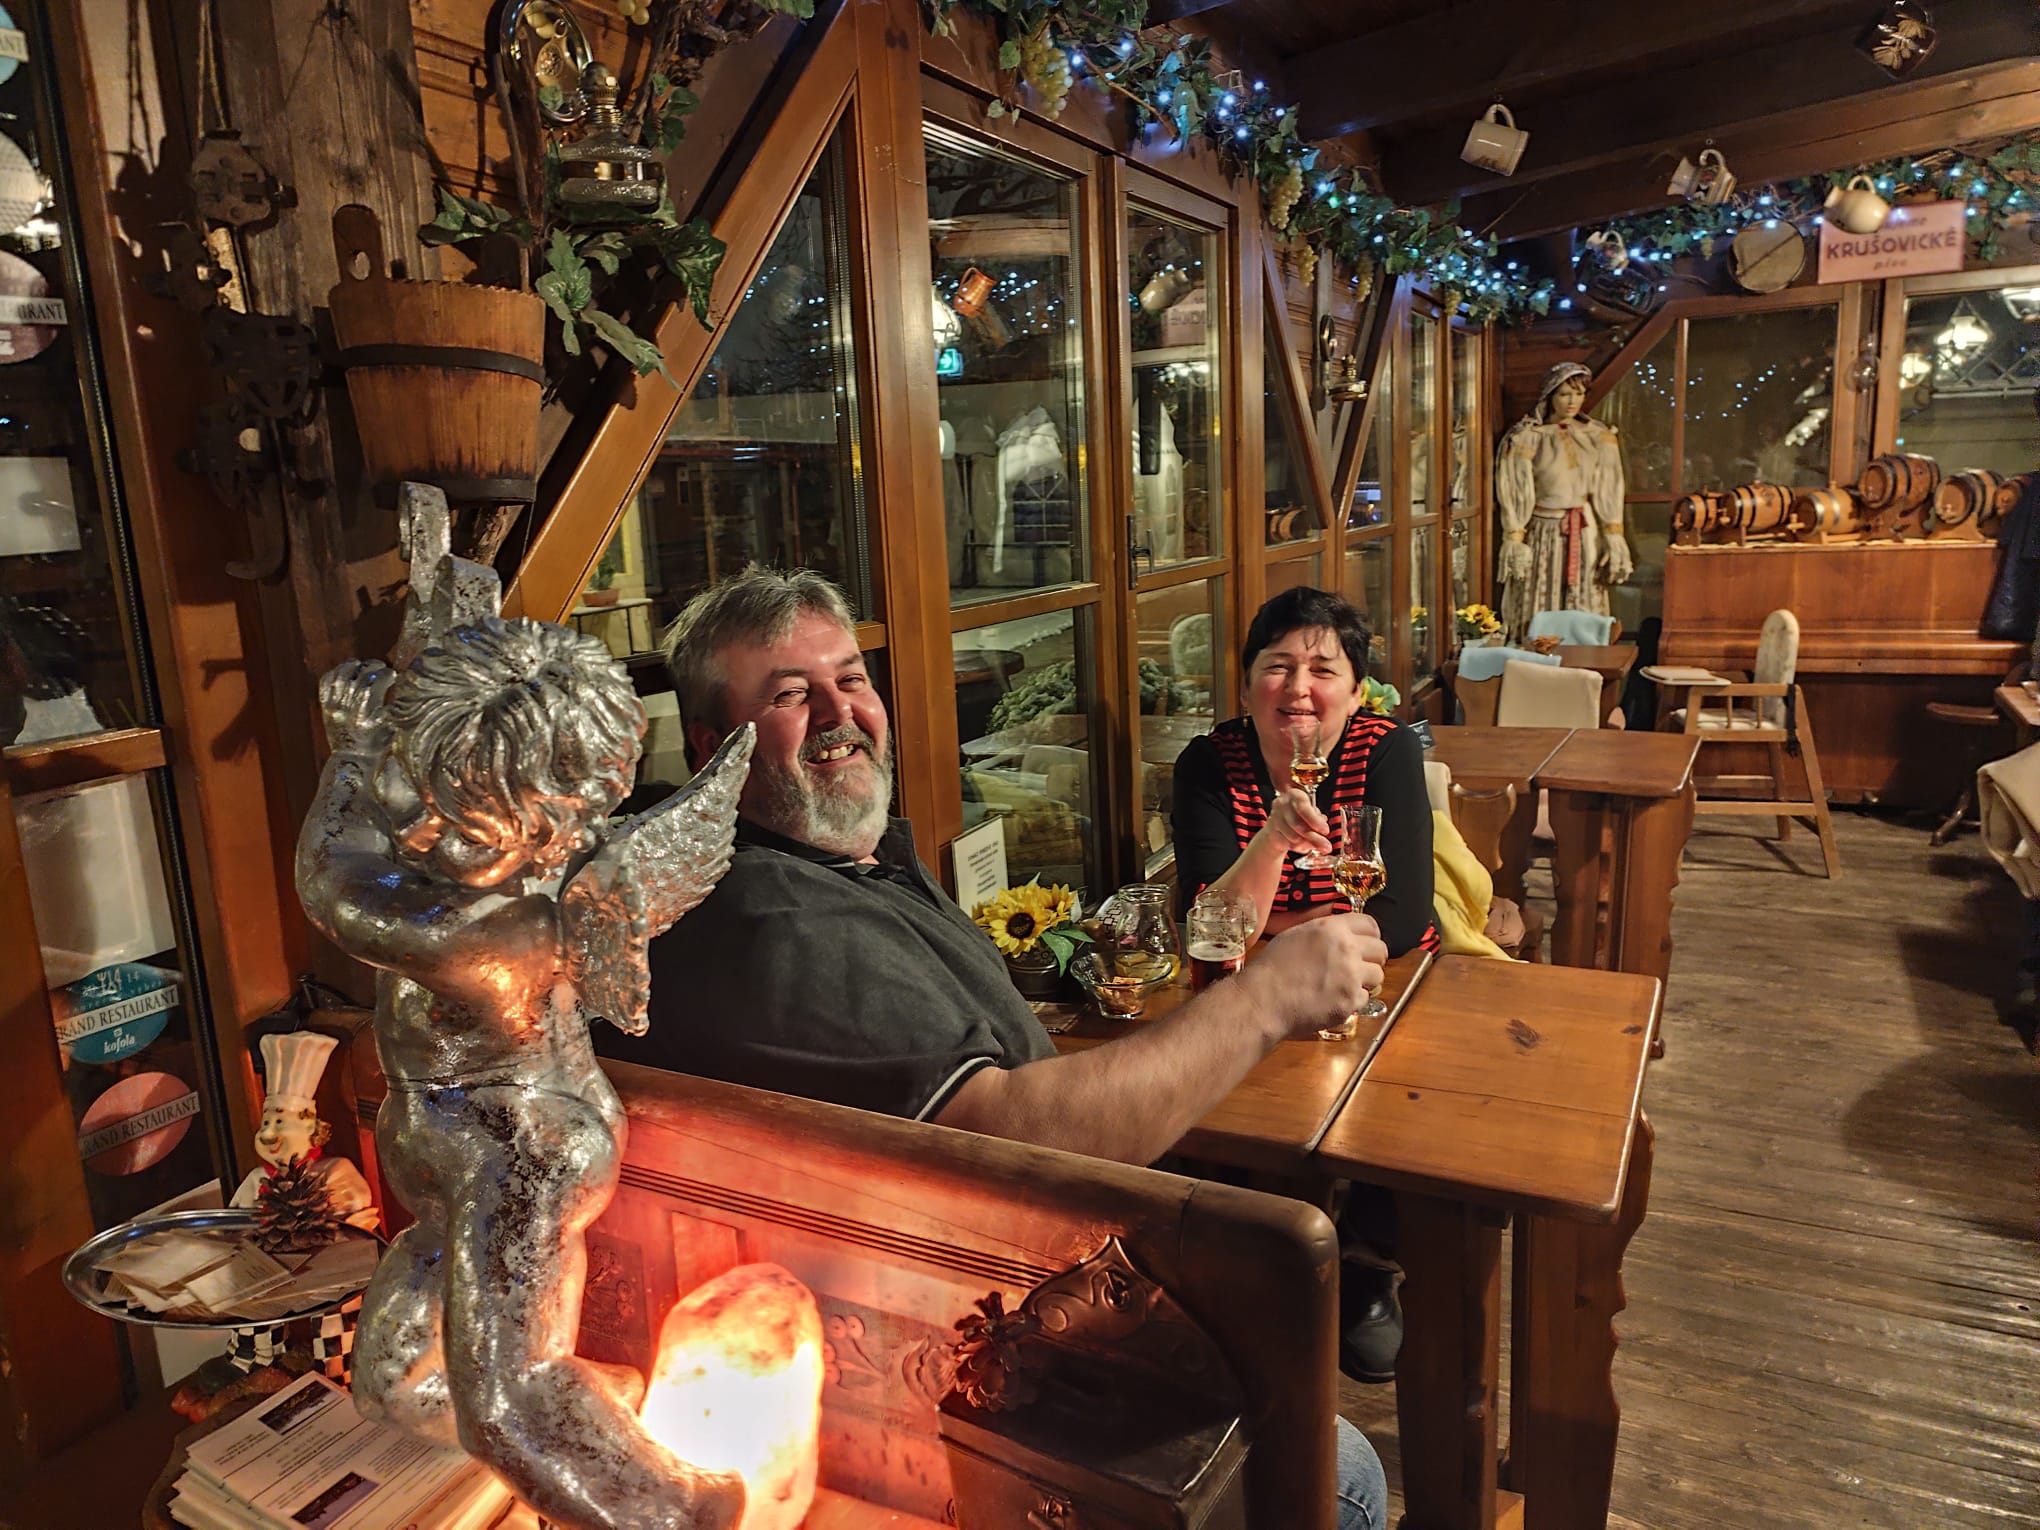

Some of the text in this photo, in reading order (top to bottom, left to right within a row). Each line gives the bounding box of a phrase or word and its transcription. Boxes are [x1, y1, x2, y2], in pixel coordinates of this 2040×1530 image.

[1827, 226, 1957, 259] KRUŠOVICKÉ
[58, 988, 177, 1040] RAND RESTAURANT
[104, 1034, 135, 1055] kofola
[83, 1096, 197, 1155] RAND RESTAURANT
